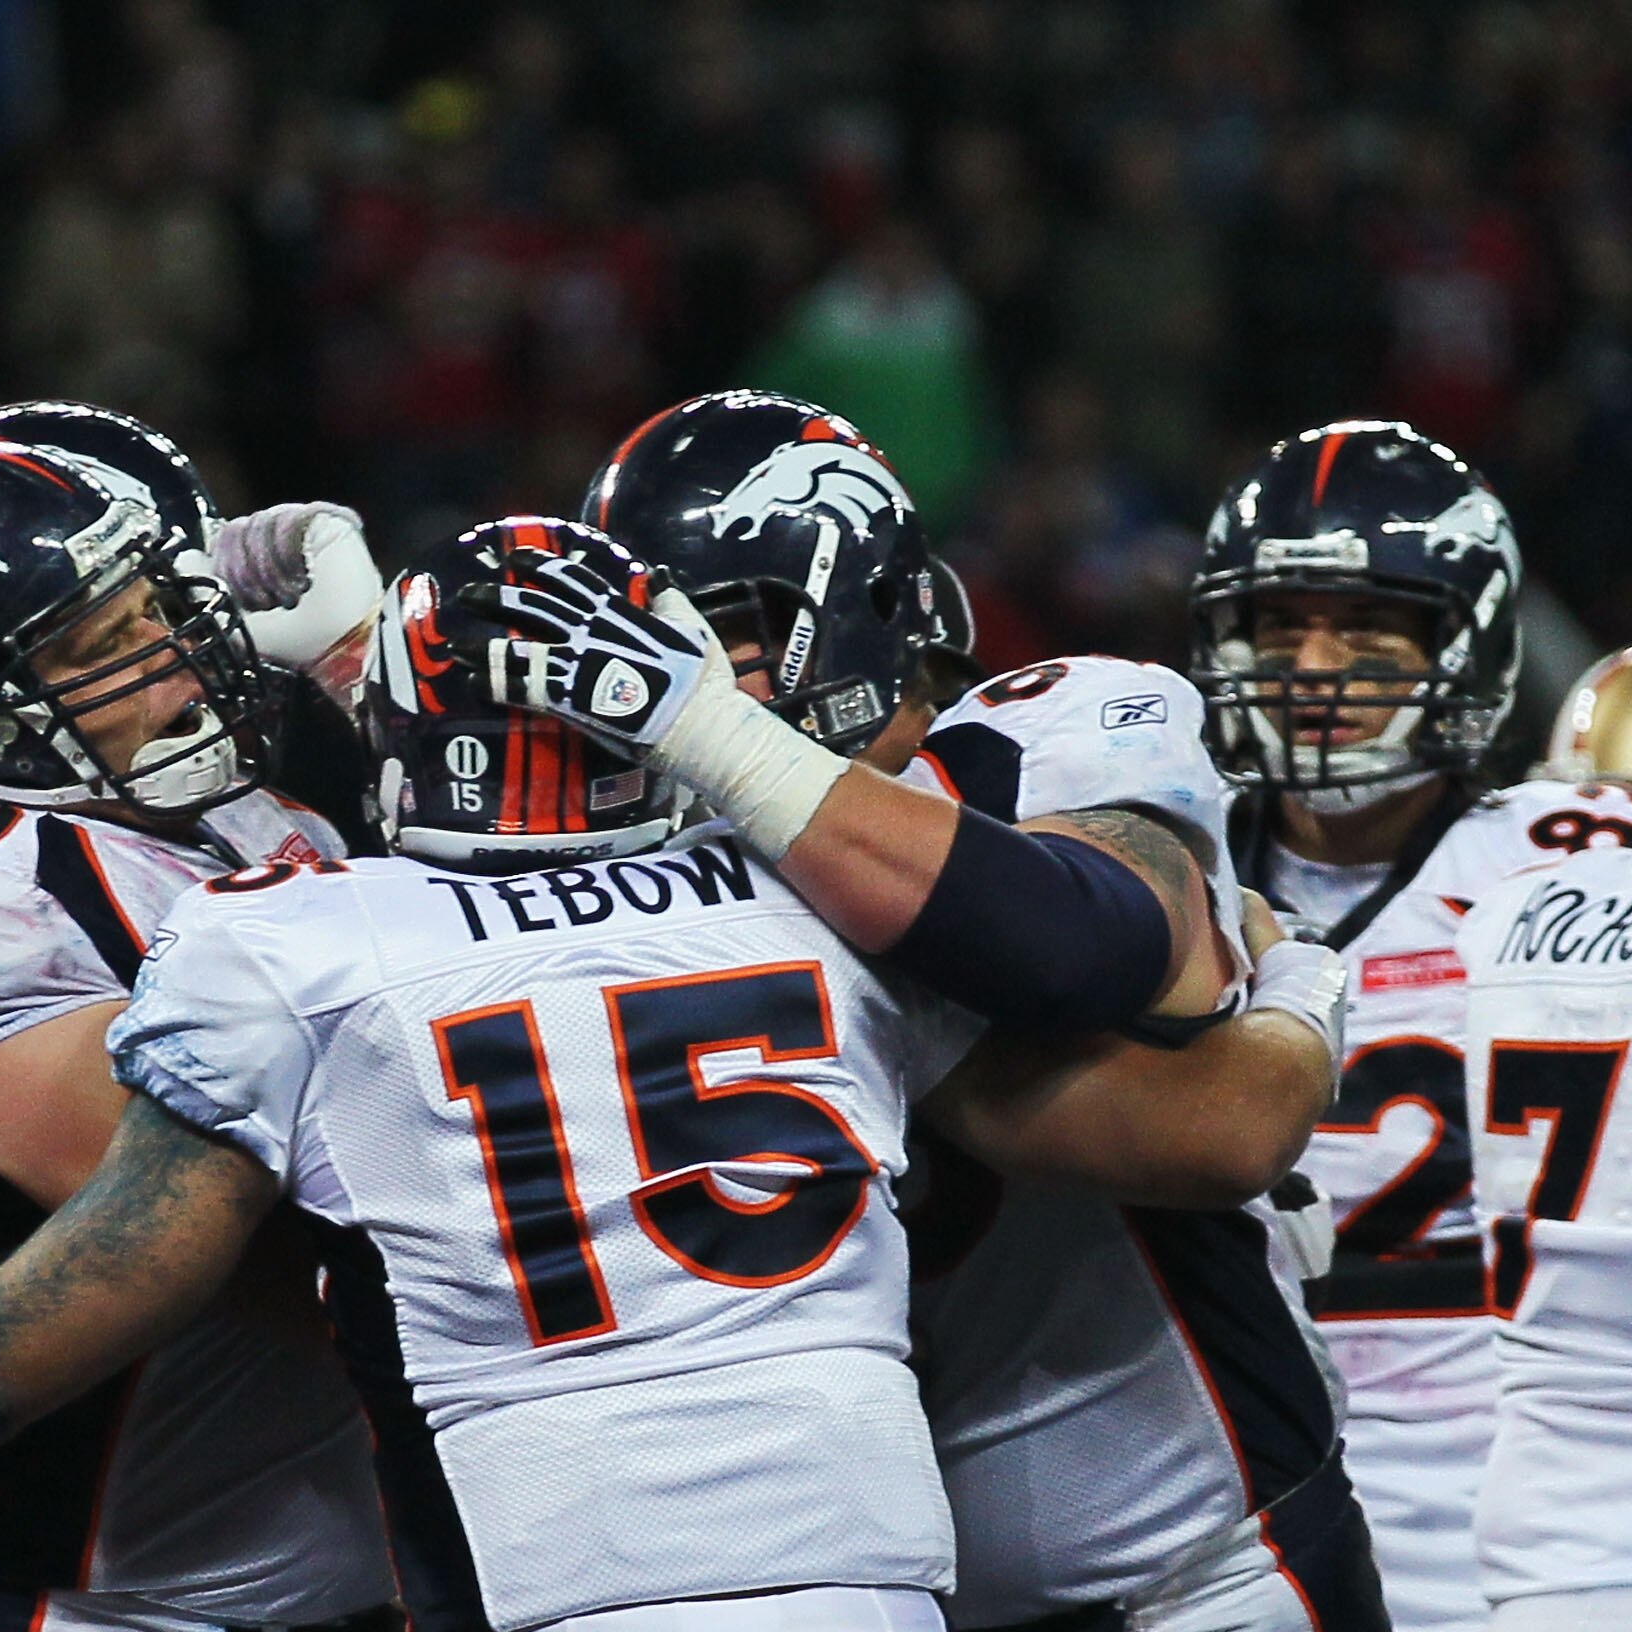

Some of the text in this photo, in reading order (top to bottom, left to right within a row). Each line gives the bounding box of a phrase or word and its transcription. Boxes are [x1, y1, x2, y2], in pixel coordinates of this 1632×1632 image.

[448, 780, 484, 813] 15
[428, 835, 757, 942] TEBOW
[428, 960, 880, 1349] 15
